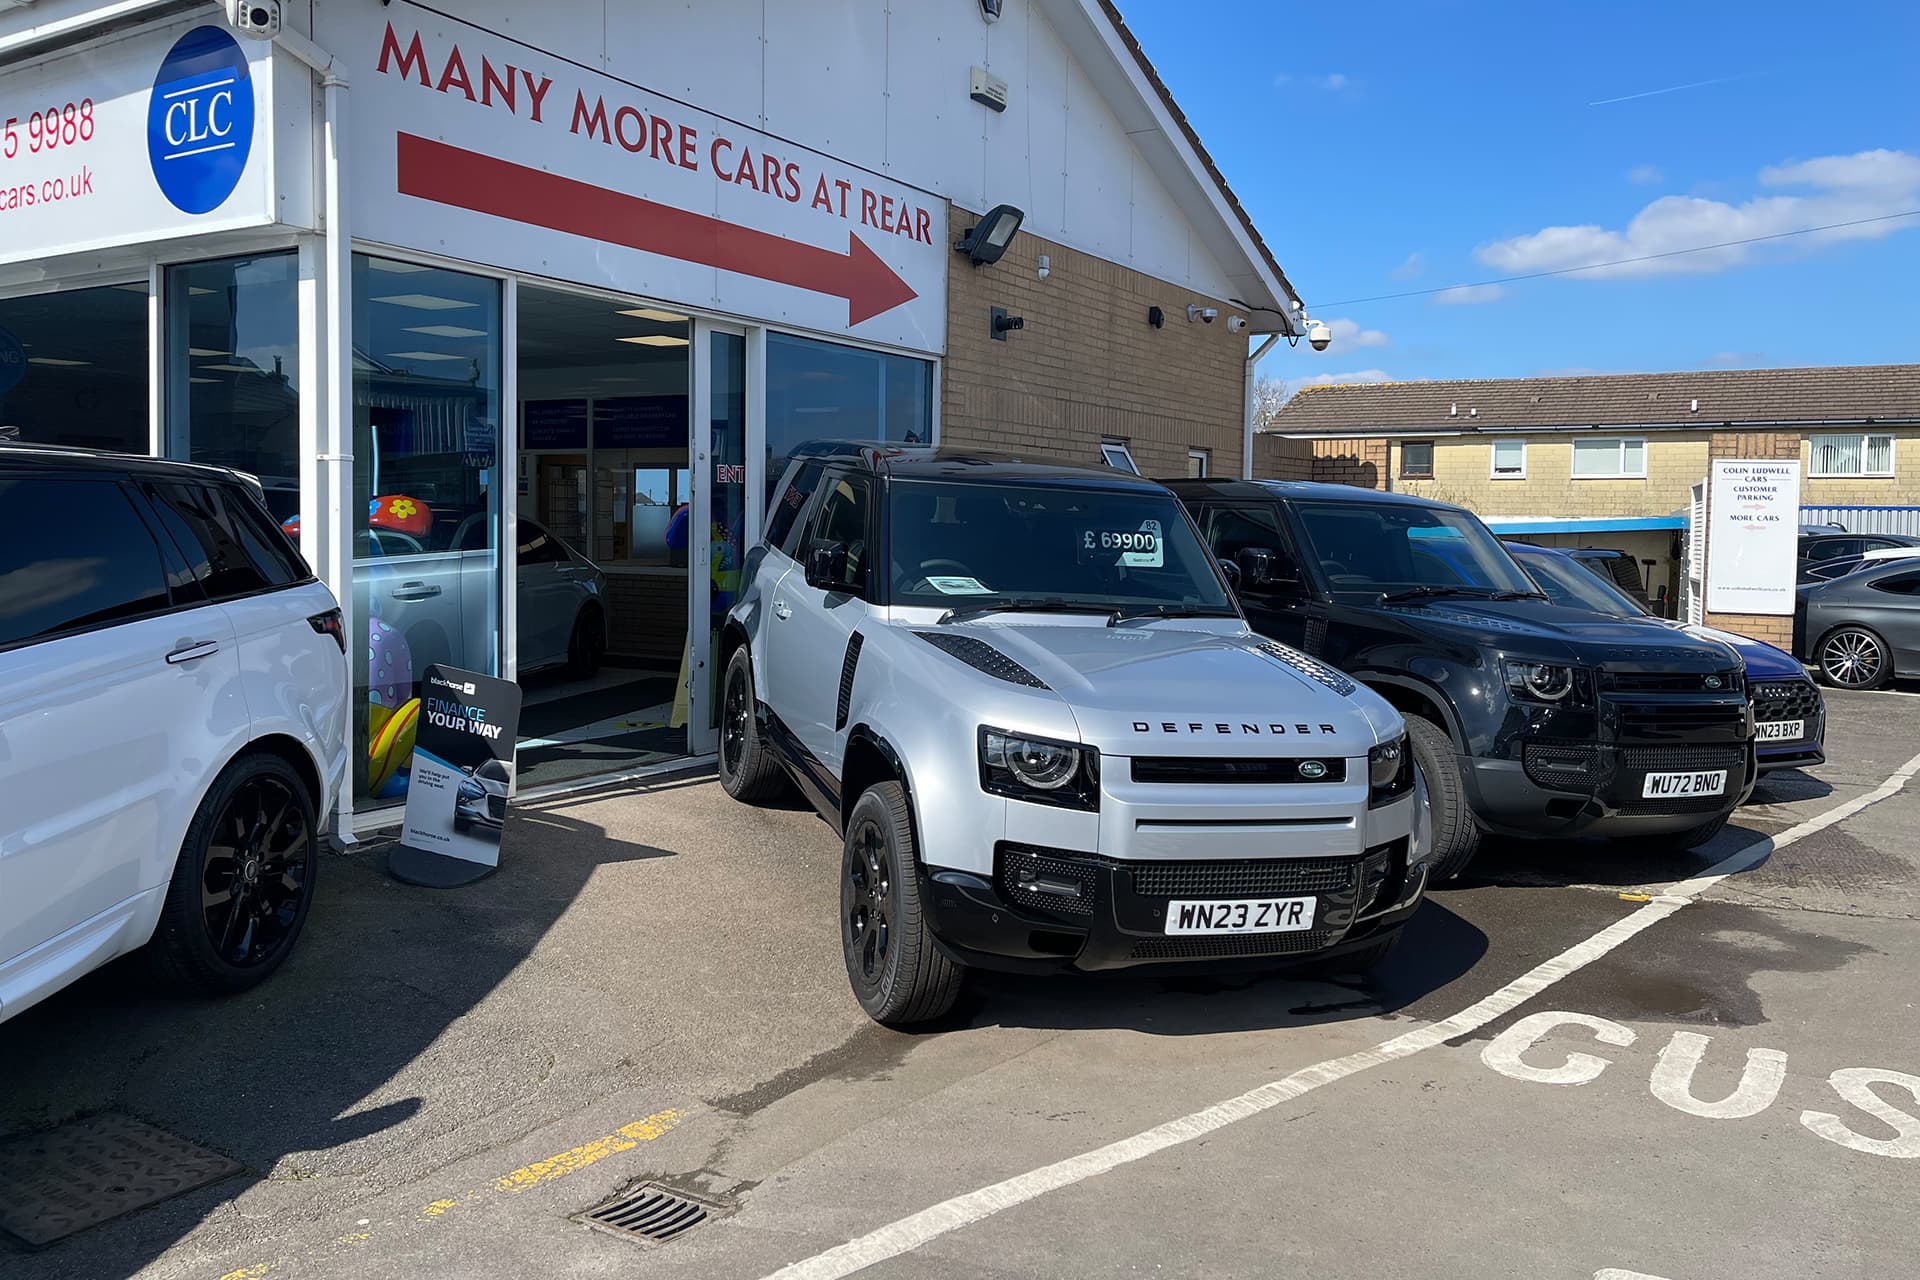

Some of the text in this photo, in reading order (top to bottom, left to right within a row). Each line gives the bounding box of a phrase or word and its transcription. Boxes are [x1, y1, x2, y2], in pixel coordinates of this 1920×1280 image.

[4, 97, 94, 159] 5 9988
[164, 91, 233, 146] CLC
[376, 20, 933, 245] MANY MORE CARS AT REAR
[1752, 467, 1791, 475] LUDWELL
[1729, 514, 1780, 522] MORE CARS
[1083, 530, 1155, 550] £ 69900
[430, 676, 464, 691] blackhorse
[427, 697, 486, 722] FINANCE
[427, 710, 502, 739] YOUR WAY
[1132, 720, 1337, 735] DEFENDER
[1782, 722, 1800, 737] BXP
[1650, 775, 1690, 794] WU72
[1177, 902, 1304, 930] WN23 ZYR
